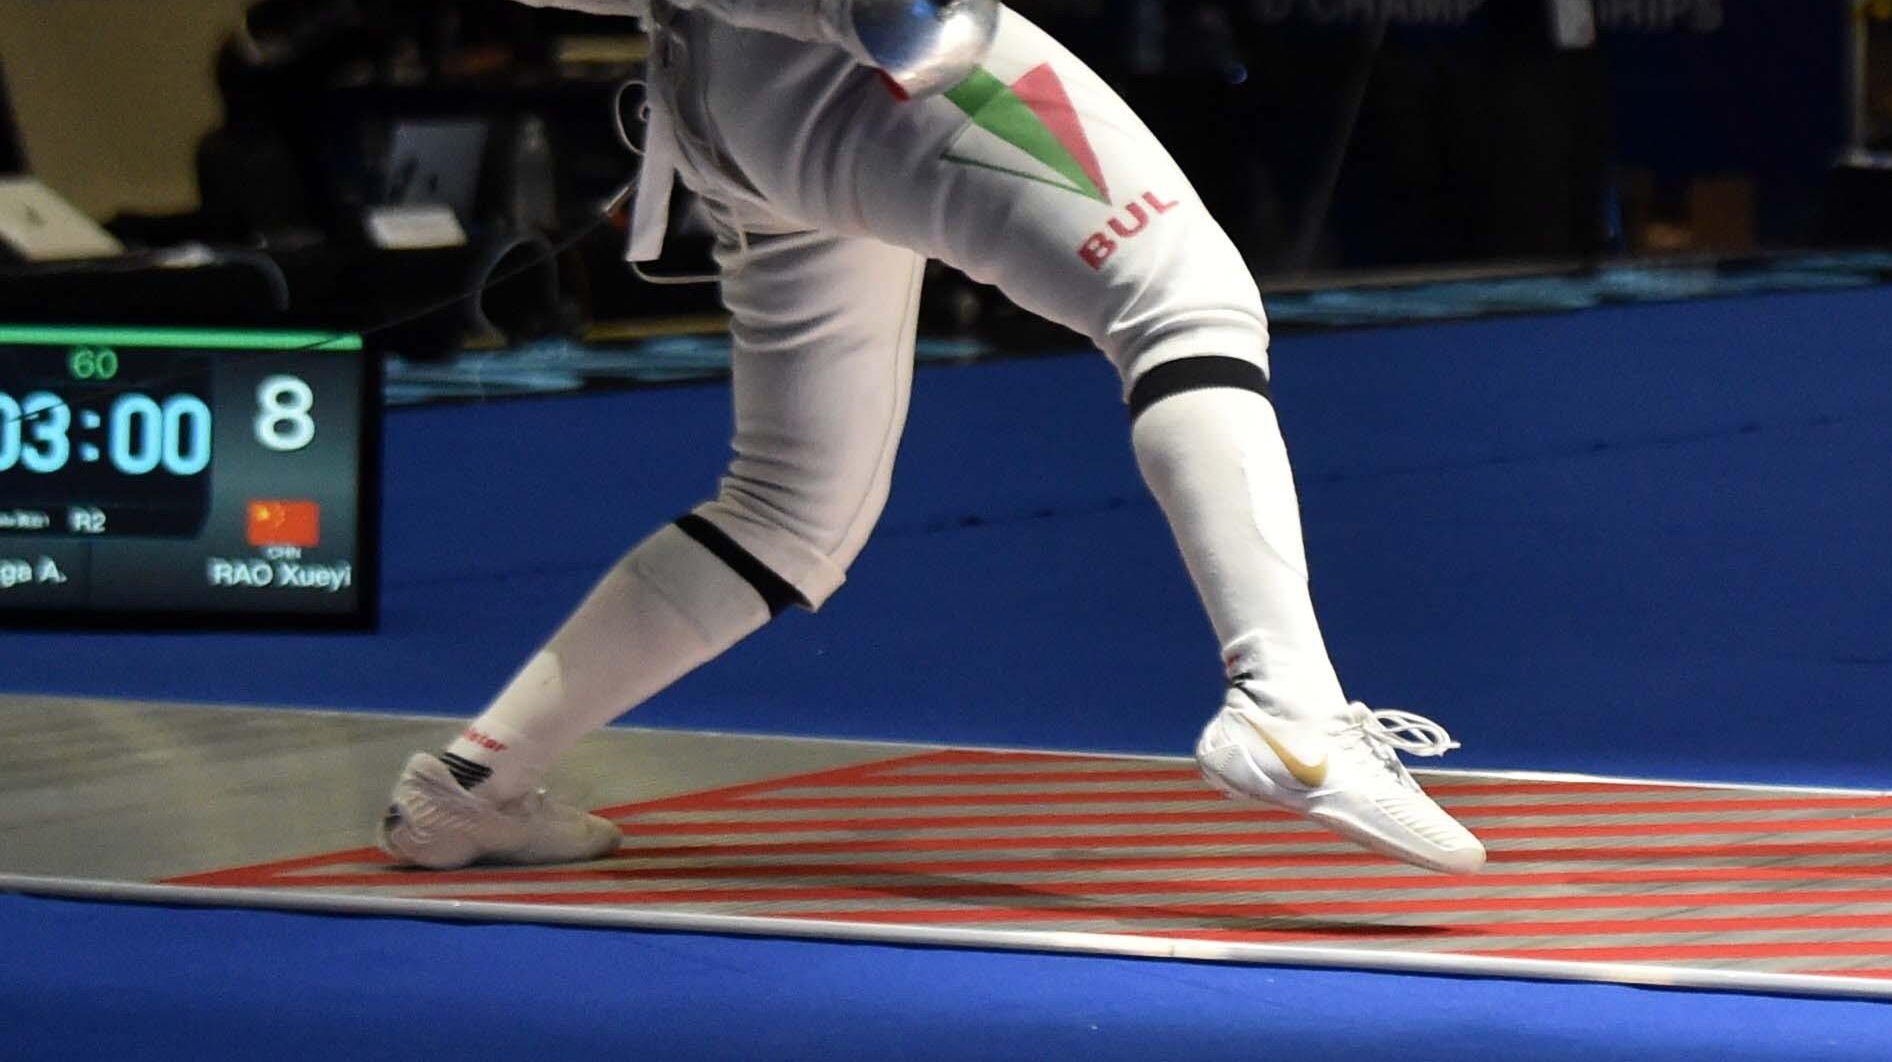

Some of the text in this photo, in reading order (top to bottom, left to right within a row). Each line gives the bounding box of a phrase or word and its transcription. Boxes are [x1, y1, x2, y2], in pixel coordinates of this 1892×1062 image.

[1076, 190, 1180, 271] BUL
[70, 349, 119, 379] 60
[255, 374, 316, 451] 8
[69, 506, 106, 533] R2
[37, 555, 68, 583] A.
[208, 557, 352, 592] RAO Xueyi
